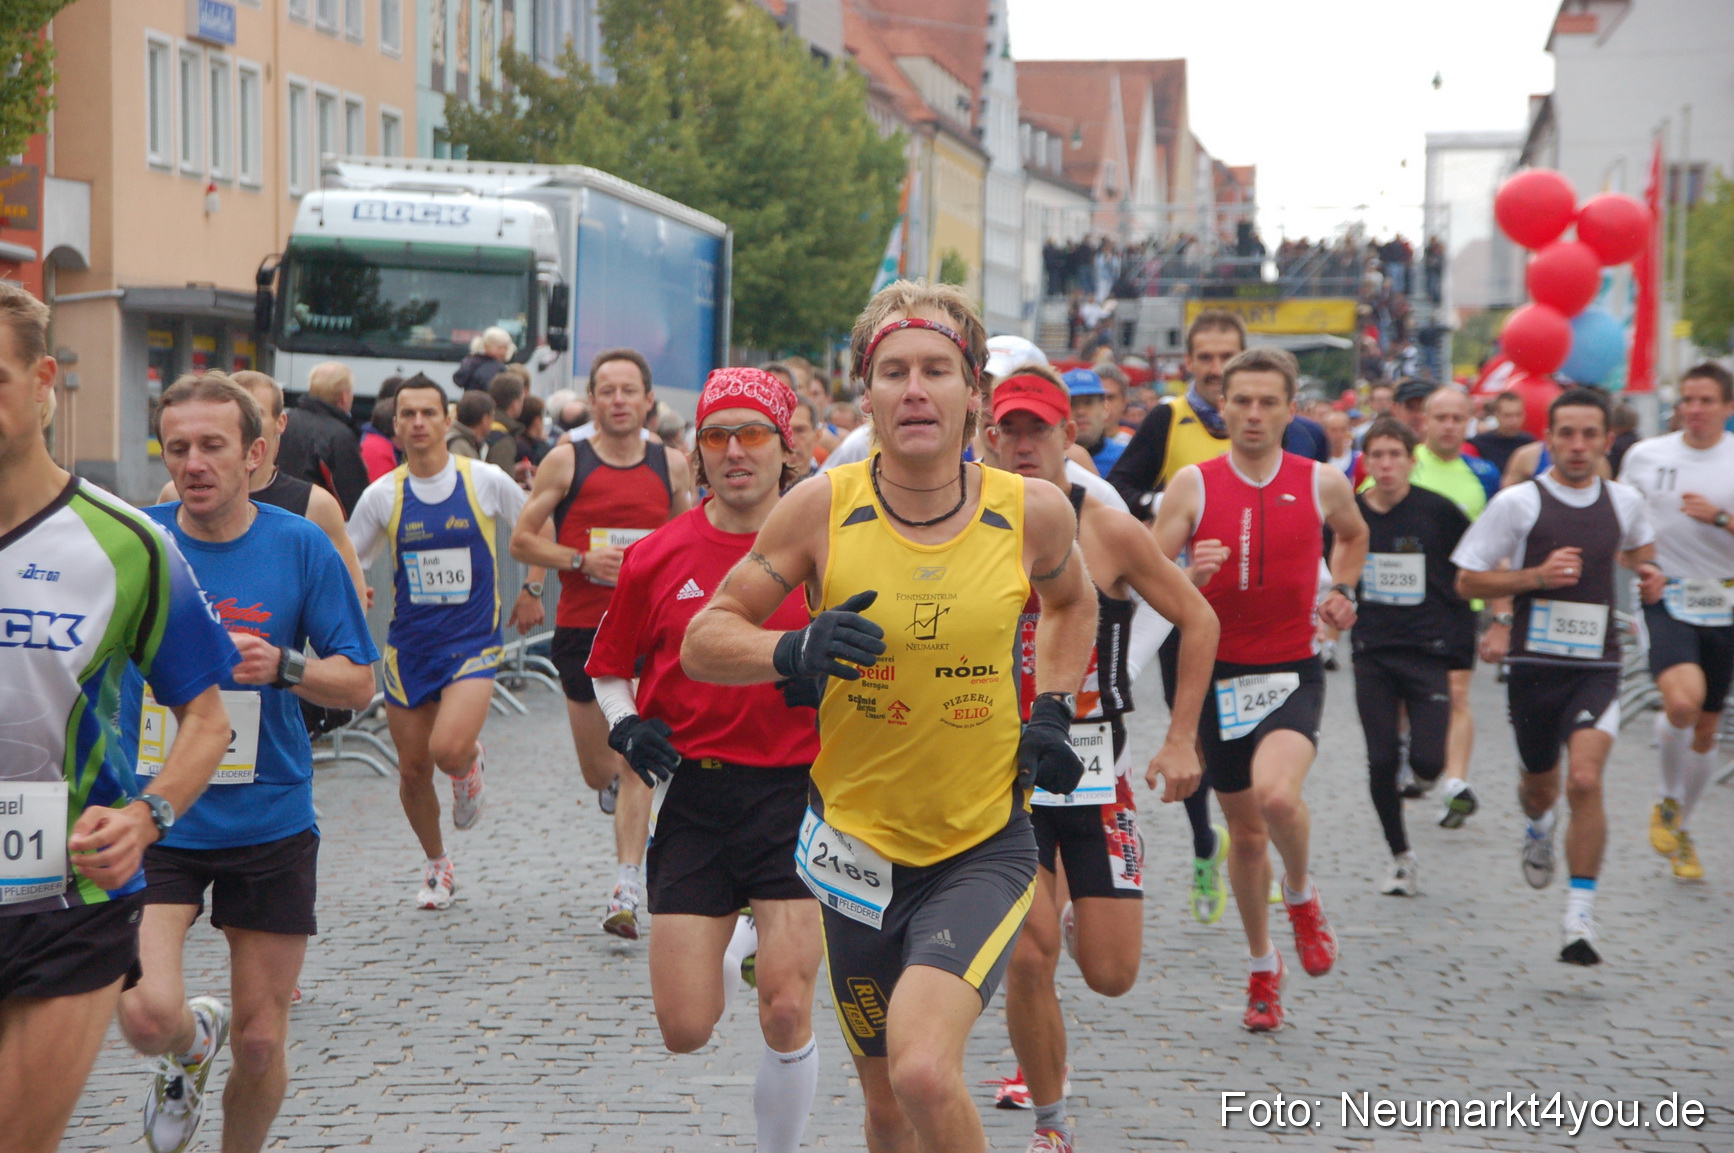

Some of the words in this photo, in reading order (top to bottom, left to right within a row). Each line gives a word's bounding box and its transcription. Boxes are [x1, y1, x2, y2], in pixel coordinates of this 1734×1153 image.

[352, 199, 471, 226] BOCK
[426, 569, 465, 586] 3136
[1380, 573, 1417, 586] 3239
[676, 590, 704, 600] adidas
[896, 593, 958, 601] FONDSZENTRUM
[1555, 618, 1598, 636] 3533
[906, 643, 949, 651] NEUMARKT
[862, 680, 889, 690] Berngau
[943, 693, 994, 710] PIZZERIA
[954, 706, 989, 720] ELIO
[145, 718, 152, 731] A
[812, 842, 881, 888] 2185
[4, 882, 63, 896] PFLEIDERER
[839, 898, 880, 922] PFLEIDERER
[846, 1003, 871, 1035] Team
